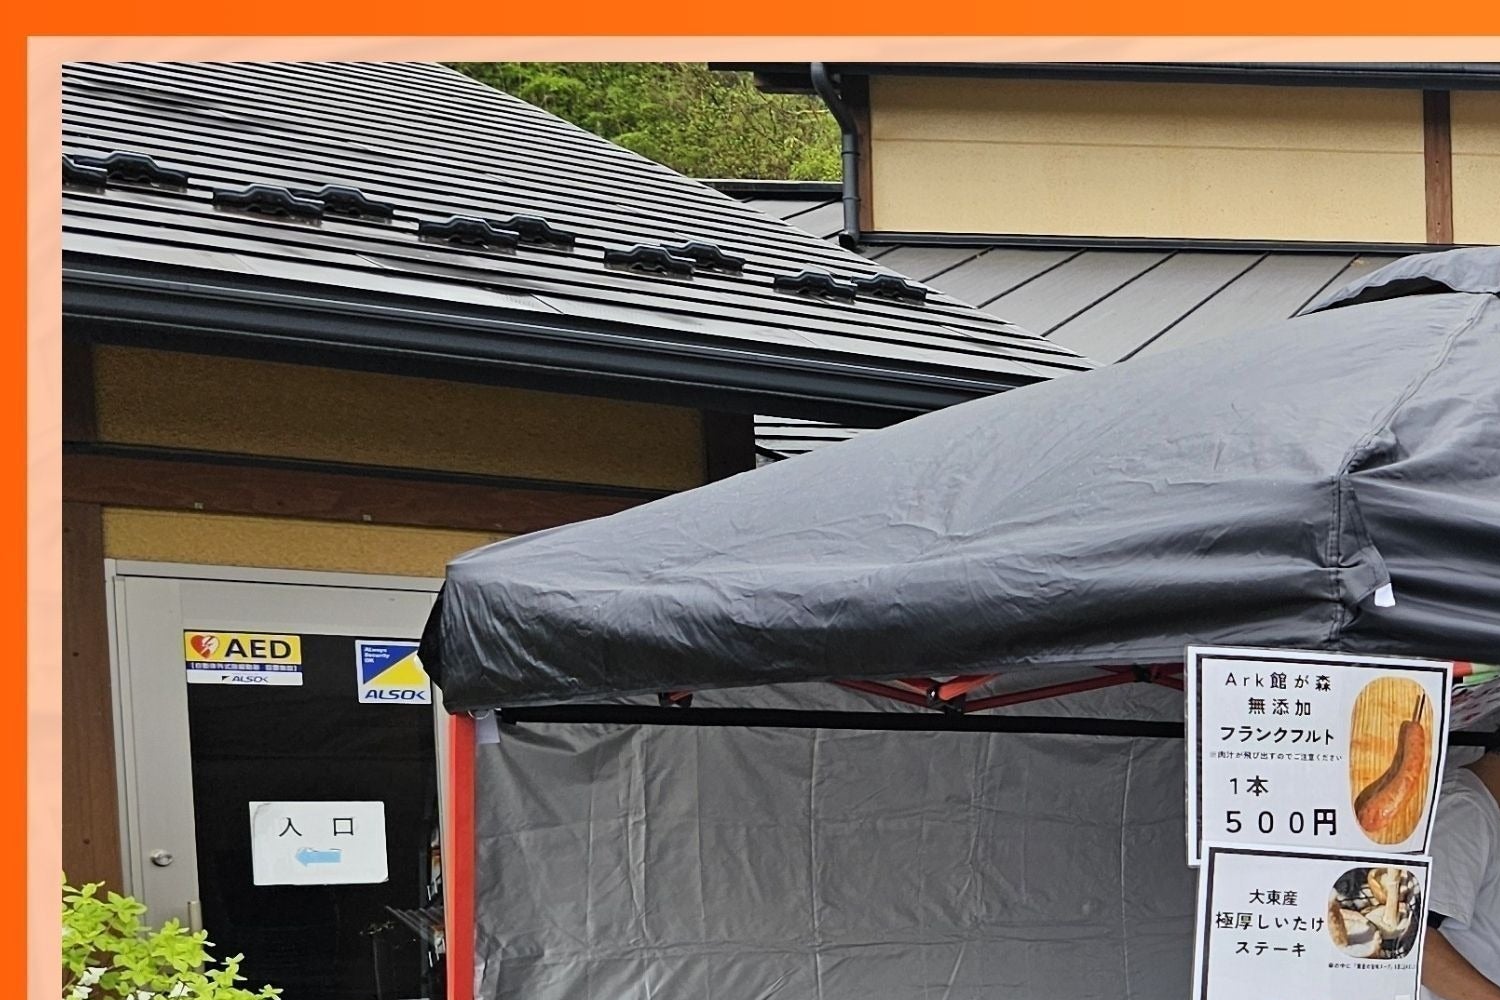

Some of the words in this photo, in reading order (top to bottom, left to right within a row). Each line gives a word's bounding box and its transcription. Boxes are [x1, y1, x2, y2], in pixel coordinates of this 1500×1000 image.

[225, 639, 291, 659] AED
[365, 689, 426, 700] ALSOK
[1248, 697, 1312, 716] 無添加
[1220, 726, 1335, 745] フランクフルト
[1229, 775, 1269, 797] 1本
[279, 816, 355, 838] 入口
[1226, 808, 1337, 836] 500円
[1249, 889, 1298, 906] 大東産
[1215, 911, 1325, 932] 極厚しいたけ
[1235, 941, 1306, 957] ステーキ
